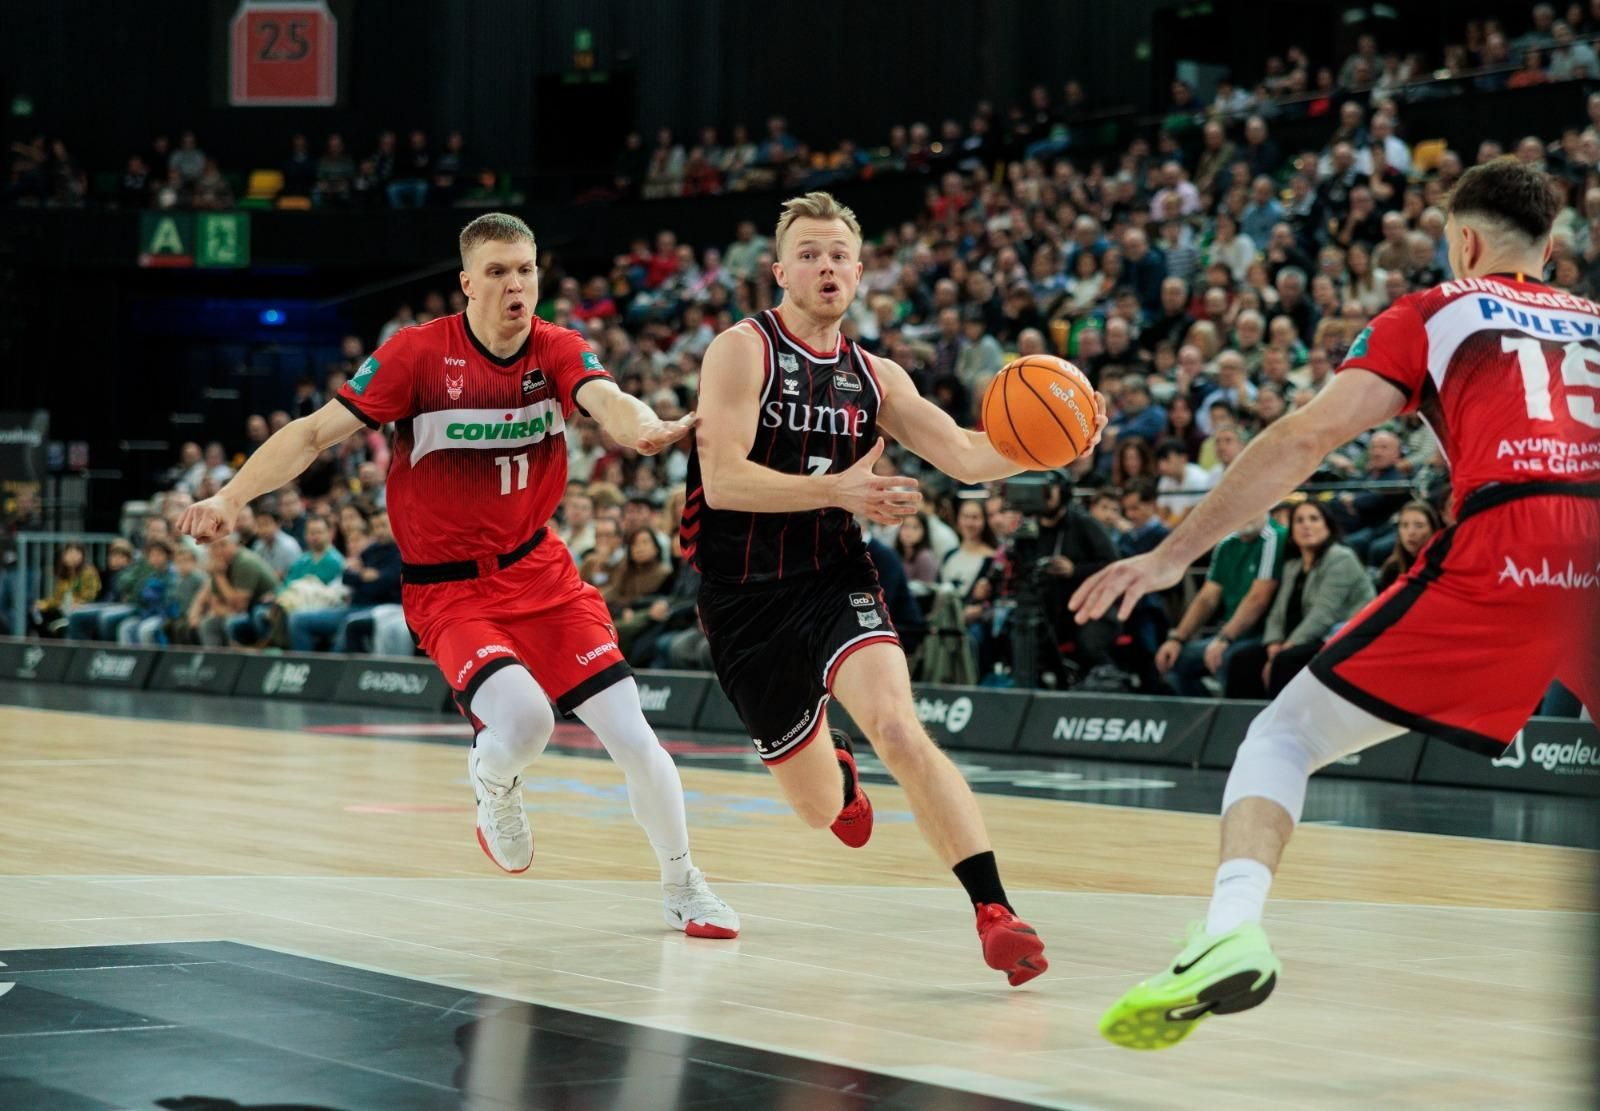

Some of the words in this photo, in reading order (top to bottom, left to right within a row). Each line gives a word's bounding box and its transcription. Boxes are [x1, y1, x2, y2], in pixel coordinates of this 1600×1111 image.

[257, 20, 311, 60] 25
[150, 217, 184, 255] A
[1478, 298, 1600, 337] PULEV
[1501, 335, 1600, 429] 15
[495, 453, 529, 495] 11
[782, 714, 810, 742] CORREO
[1053, 716, 1167, 744] NISSAN
